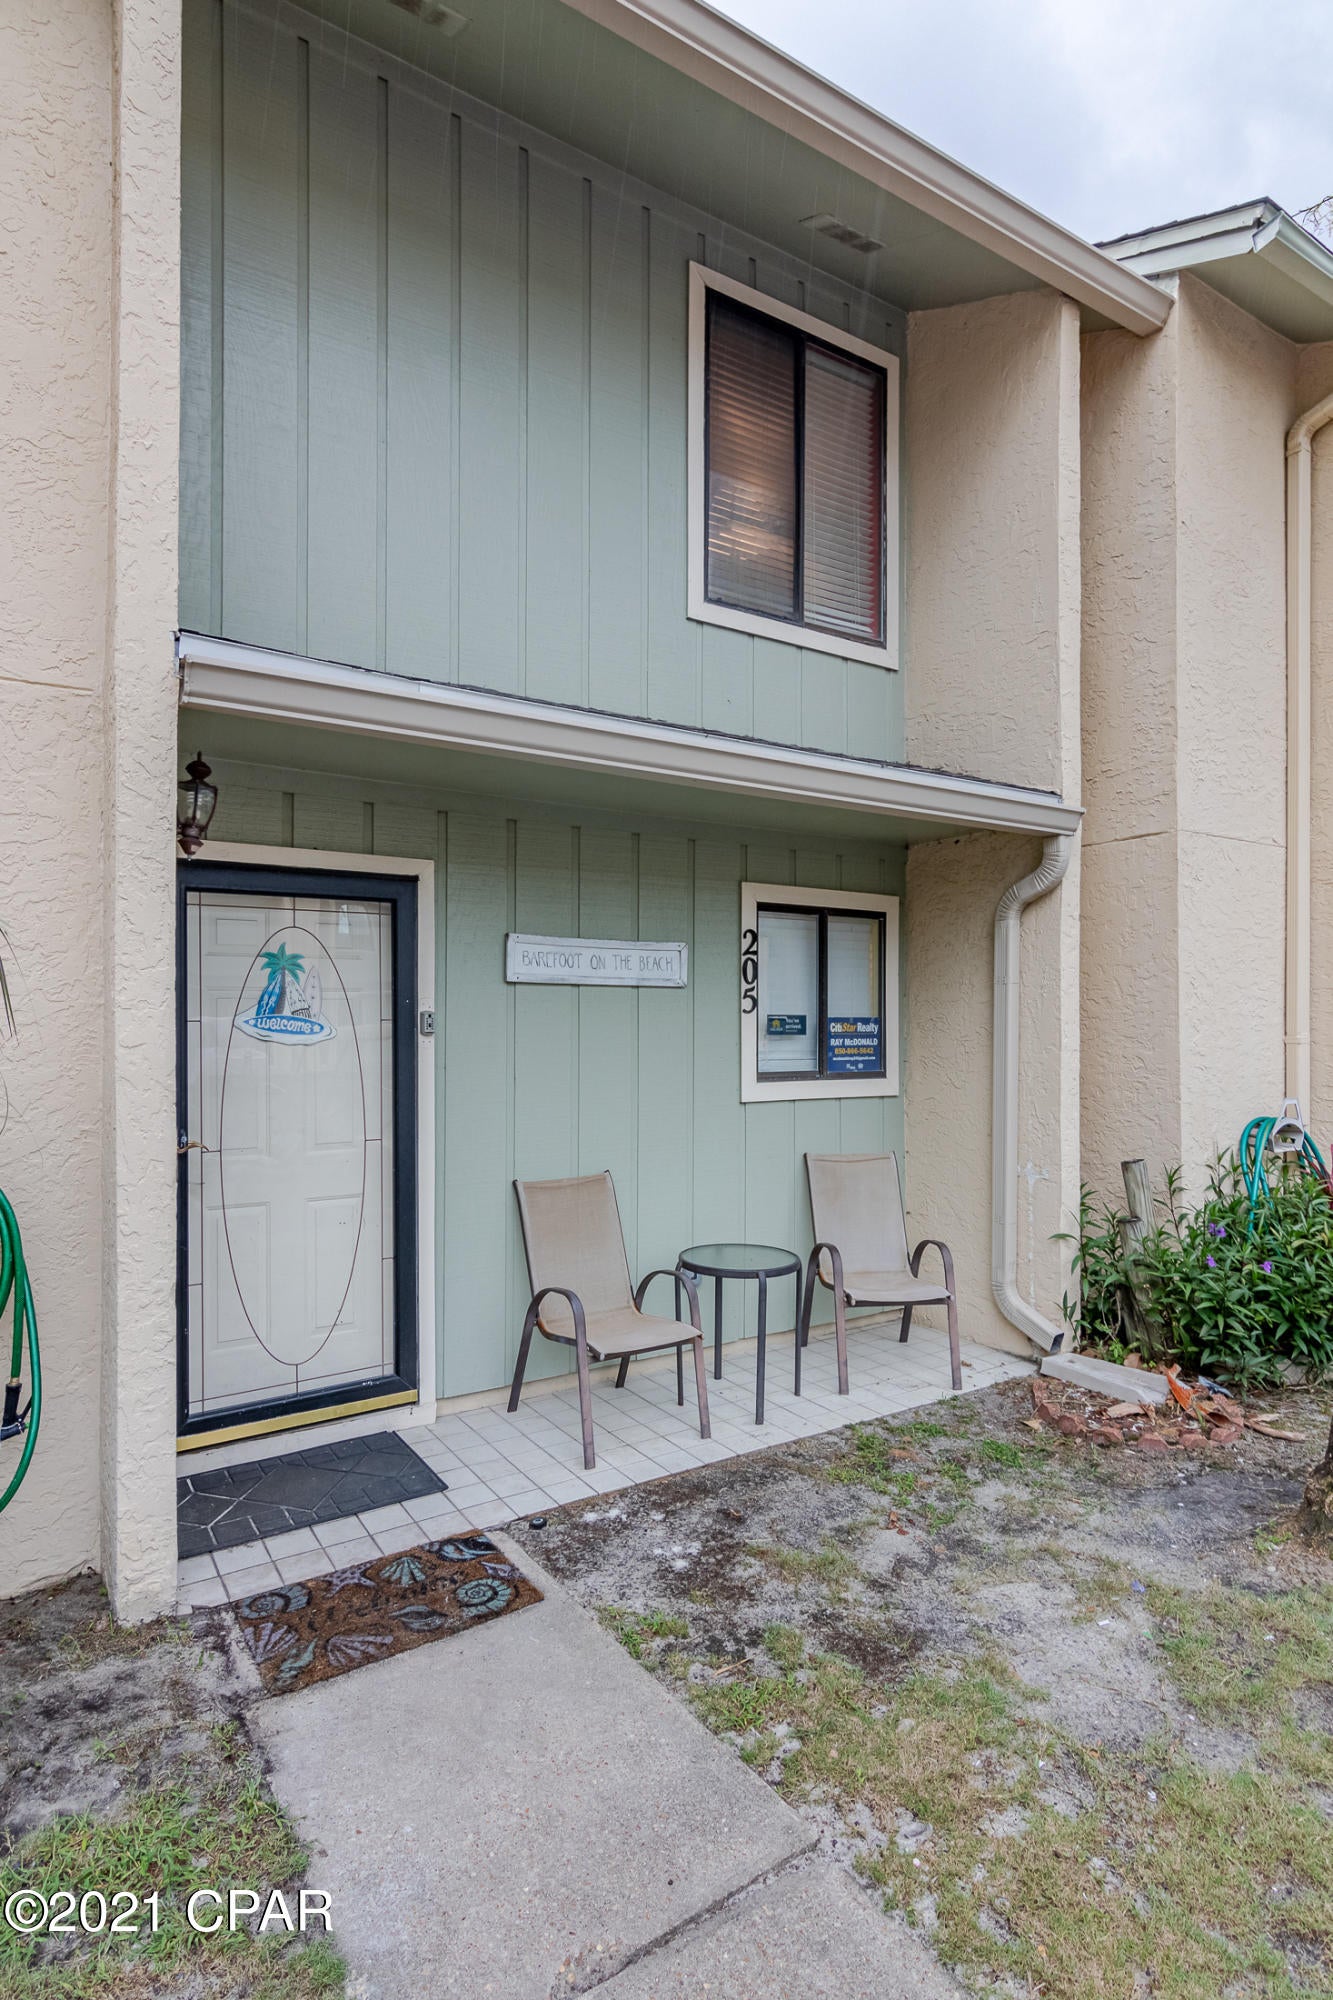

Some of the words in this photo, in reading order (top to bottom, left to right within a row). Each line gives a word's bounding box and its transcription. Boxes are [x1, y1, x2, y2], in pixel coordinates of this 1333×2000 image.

[521, 951, 583, 969] BAREFOOT
[590, 954, 606, 970] ON
[612, 954, 632, 971] THE
[639, 955, 673, 972] BEACH
[742, 928, 759, 1014] 205
[856, 1022, 879, 1035] Realty
[830, 1038, 844, 1047] RAY
